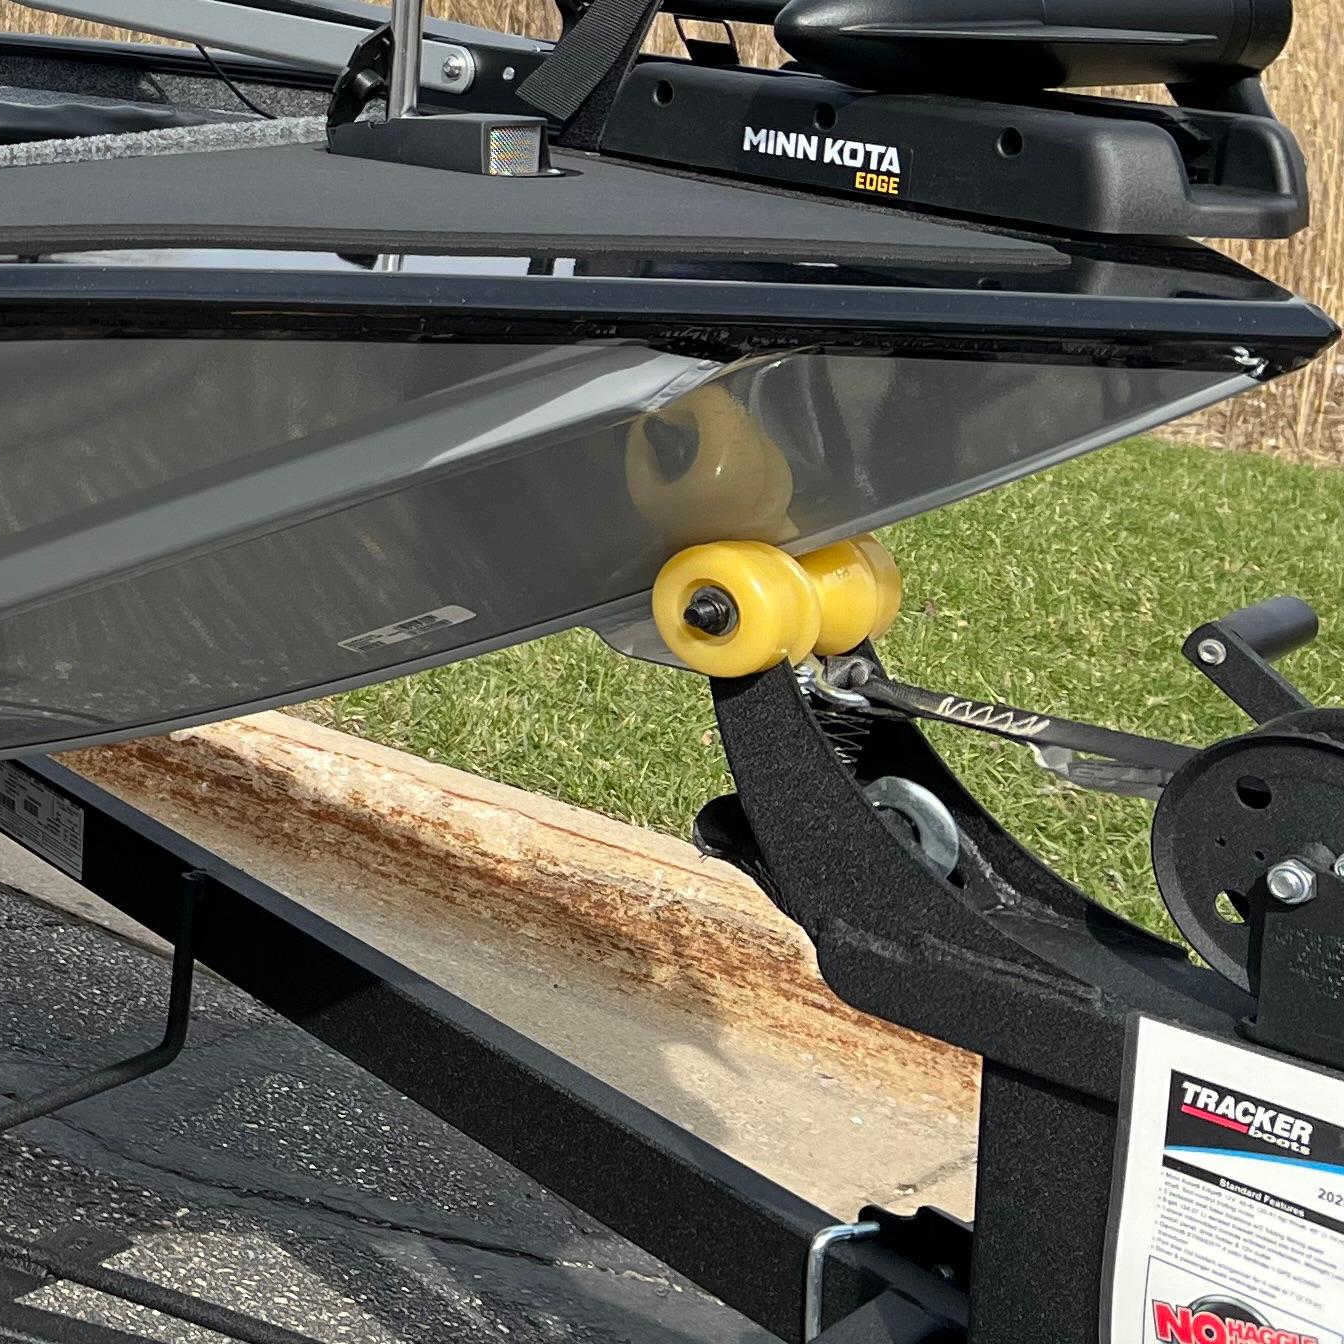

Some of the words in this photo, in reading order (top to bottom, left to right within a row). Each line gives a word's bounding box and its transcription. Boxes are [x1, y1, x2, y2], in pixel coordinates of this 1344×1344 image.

[743, 126, 819, 162] MINN
[823, 137, 901, 175] KOTA
[855, 171, 900, 195] EDGE
[1181, 1080, 1314, 1145] TRACKER
[1248, 1125, 1311, 1156] boats
[1219, 1177, 1263, 1201] Standard
[1264, 1193, 1306, 1219] Features
[1152, 1299, 1227, 1344] NO
